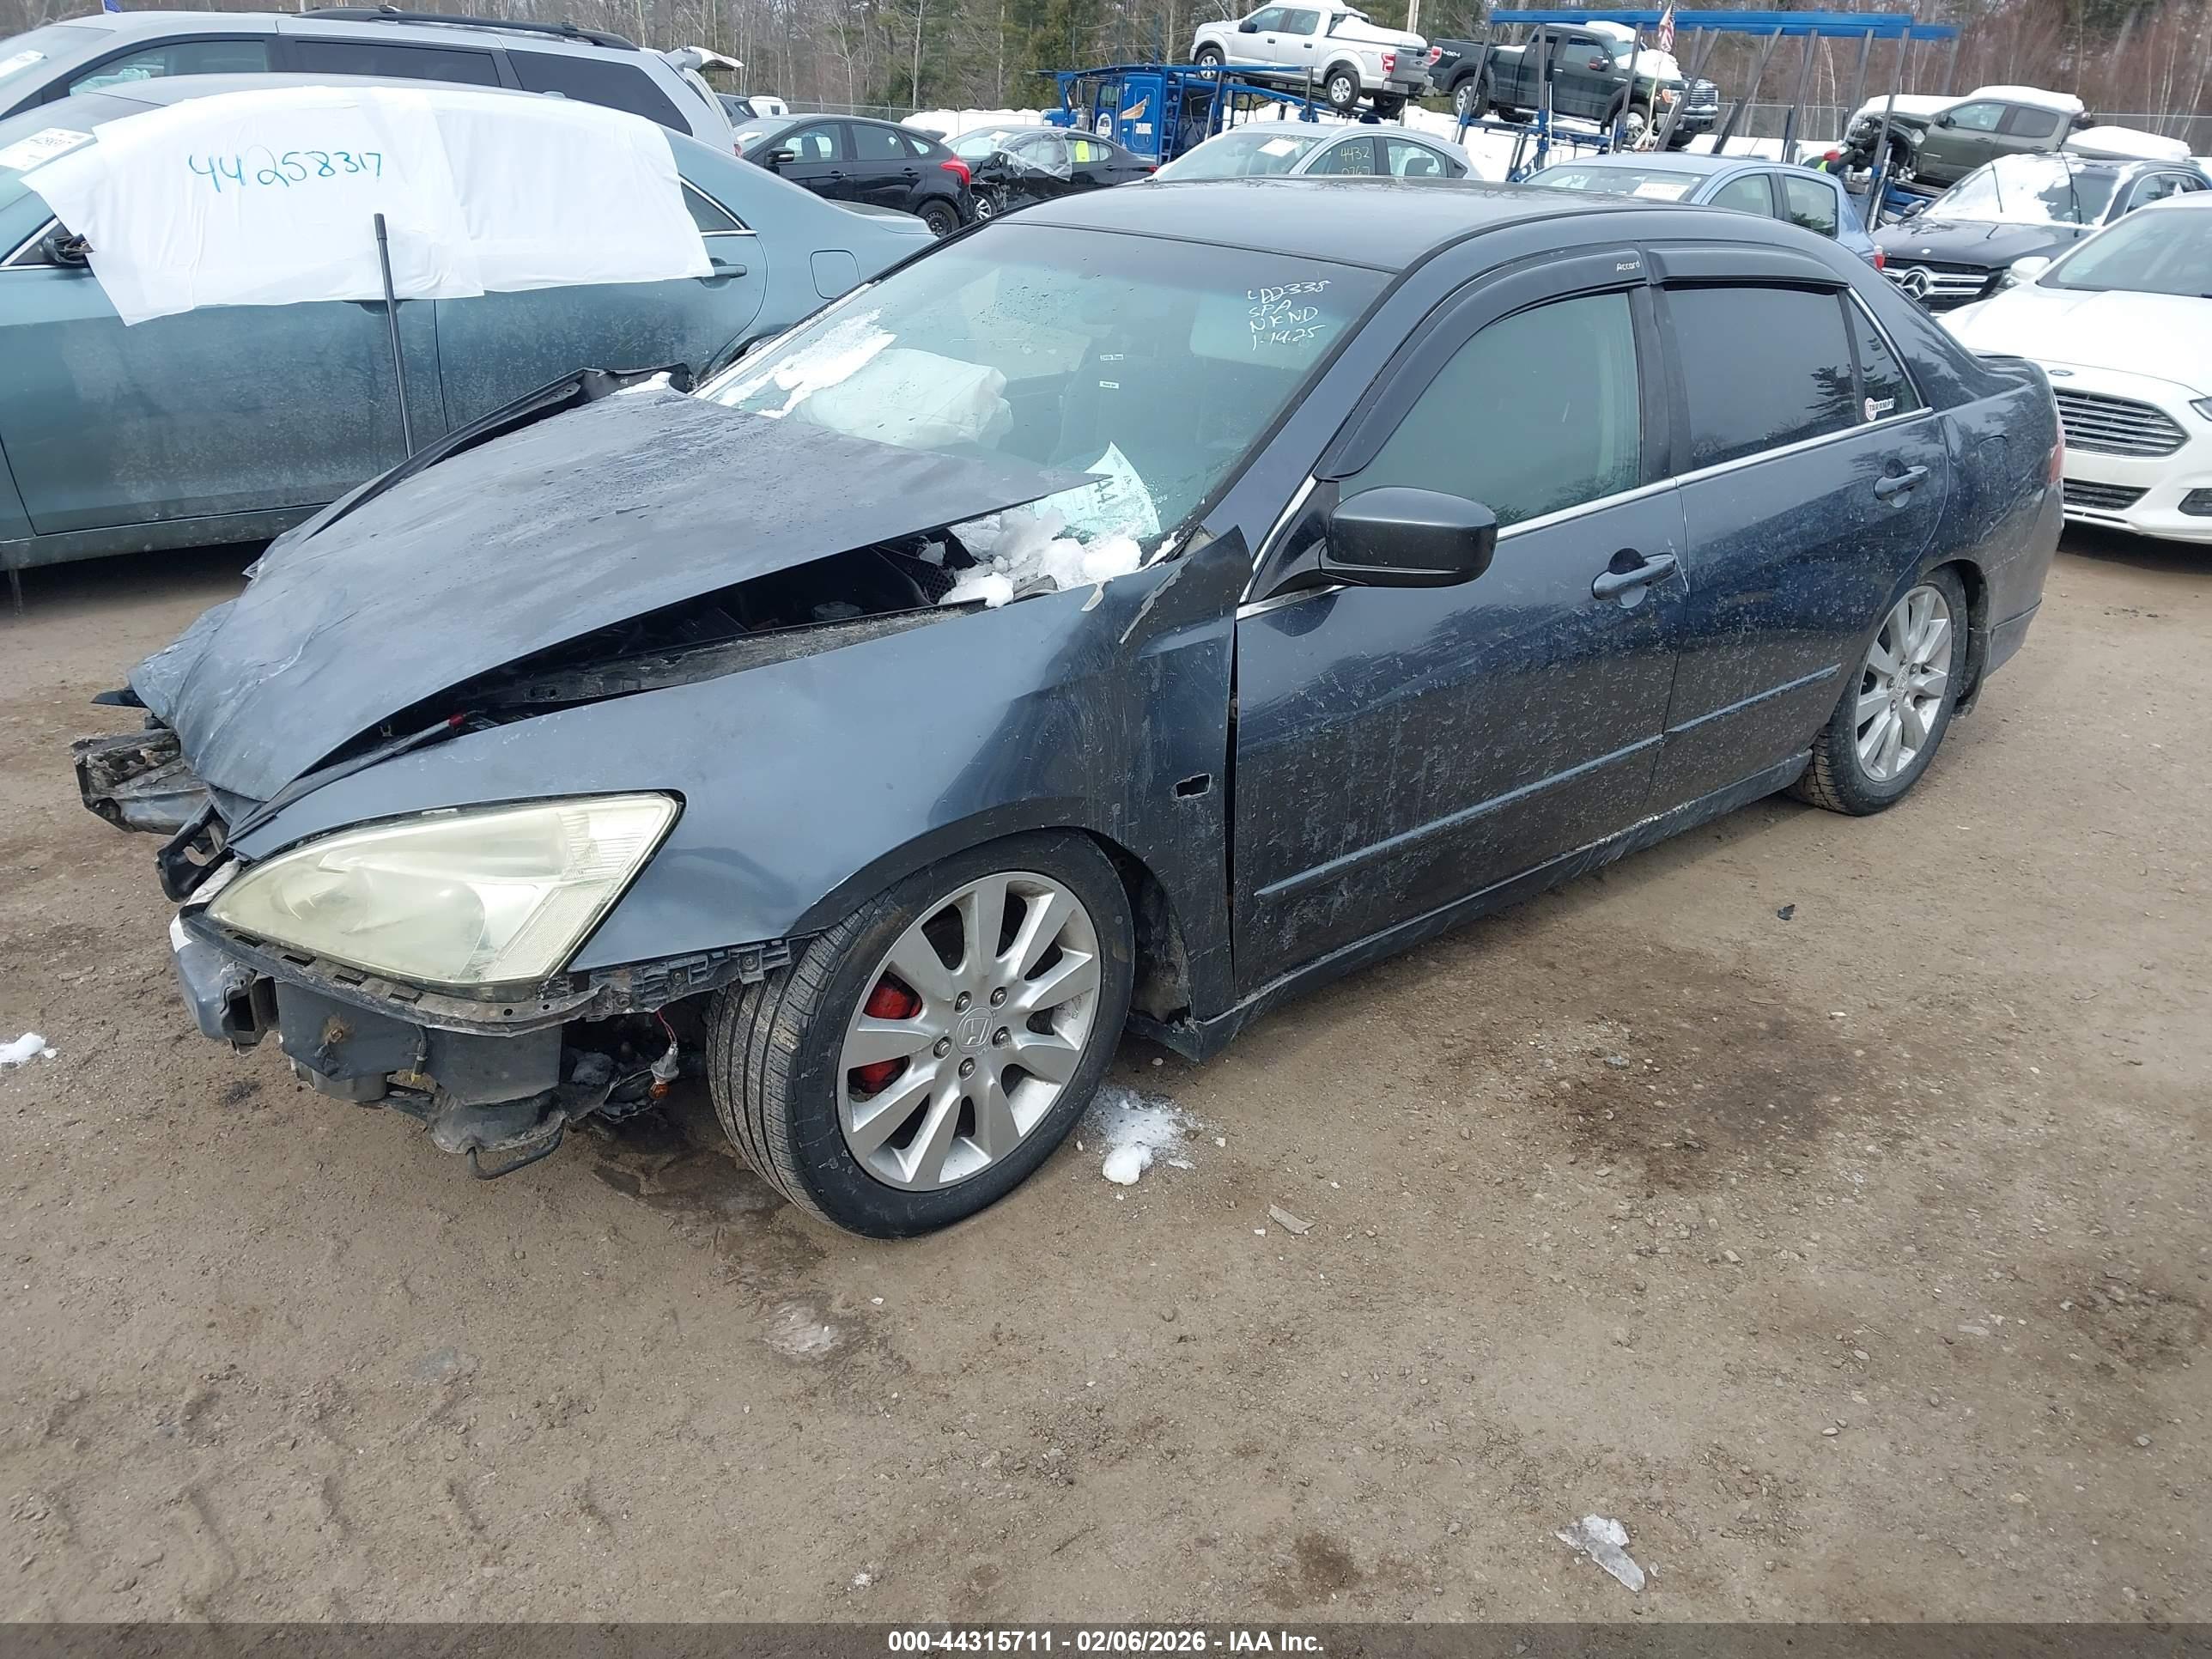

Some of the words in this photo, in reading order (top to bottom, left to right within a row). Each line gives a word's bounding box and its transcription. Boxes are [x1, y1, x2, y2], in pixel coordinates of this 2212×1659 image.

[1340, 146, 1371, 162] 4432
[188, 144, 381, 193] 44258317
[1616, 260, 1640, 272] Accord
